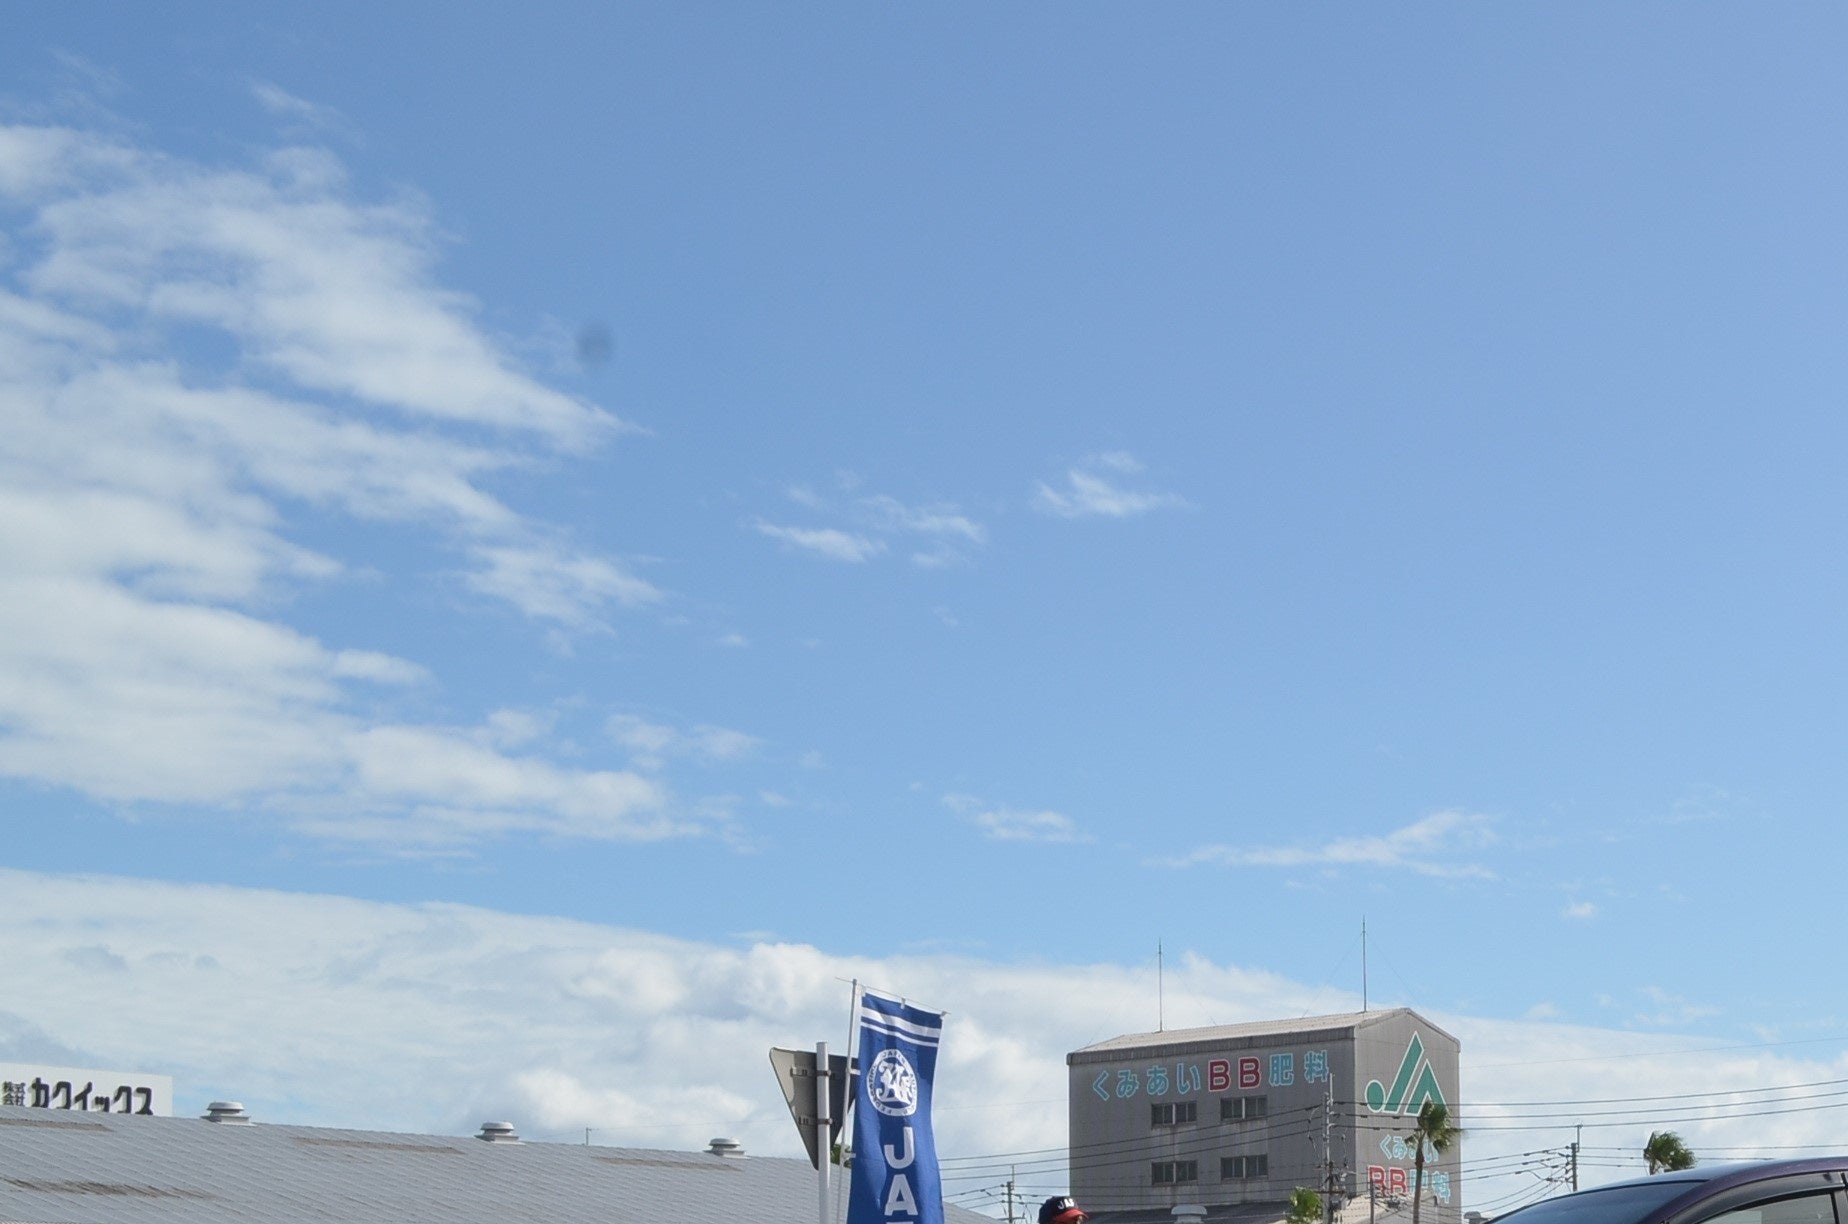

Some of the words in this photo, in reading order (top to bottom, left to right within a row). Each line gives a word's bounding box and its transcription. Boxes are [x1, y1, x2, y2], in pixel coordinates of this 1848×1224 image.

[31, 1077, 153, 1116] カクイックス
[1092, 1050, 1330, 1101] くみあいBB肥料
